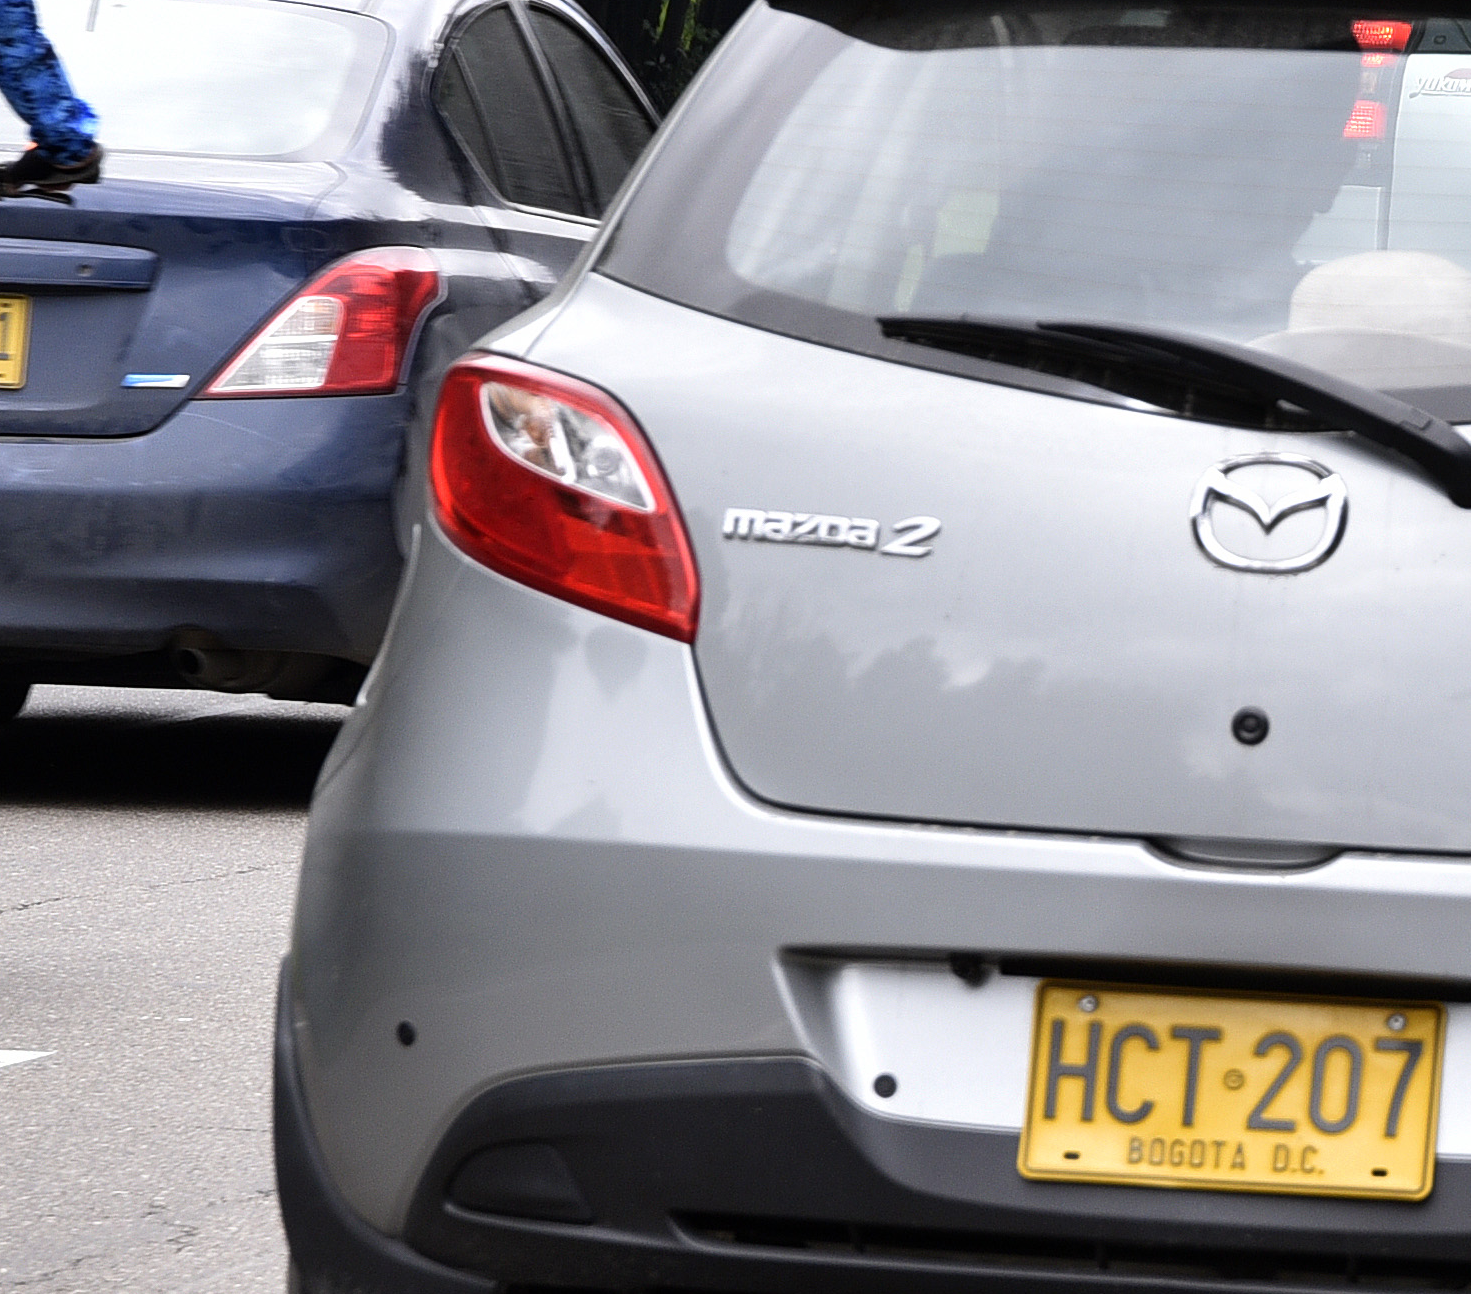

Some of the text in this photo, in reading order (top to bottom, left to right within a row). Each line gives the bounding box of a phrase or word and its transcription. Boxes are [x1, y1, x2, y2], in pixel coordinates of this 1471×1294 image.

[722, 507, 941, 557] mazda 2
[1042, 1018, 1425, 1140] HCT 207
[1127, 1135, 1325, 1176] BOGOTA D.C.
